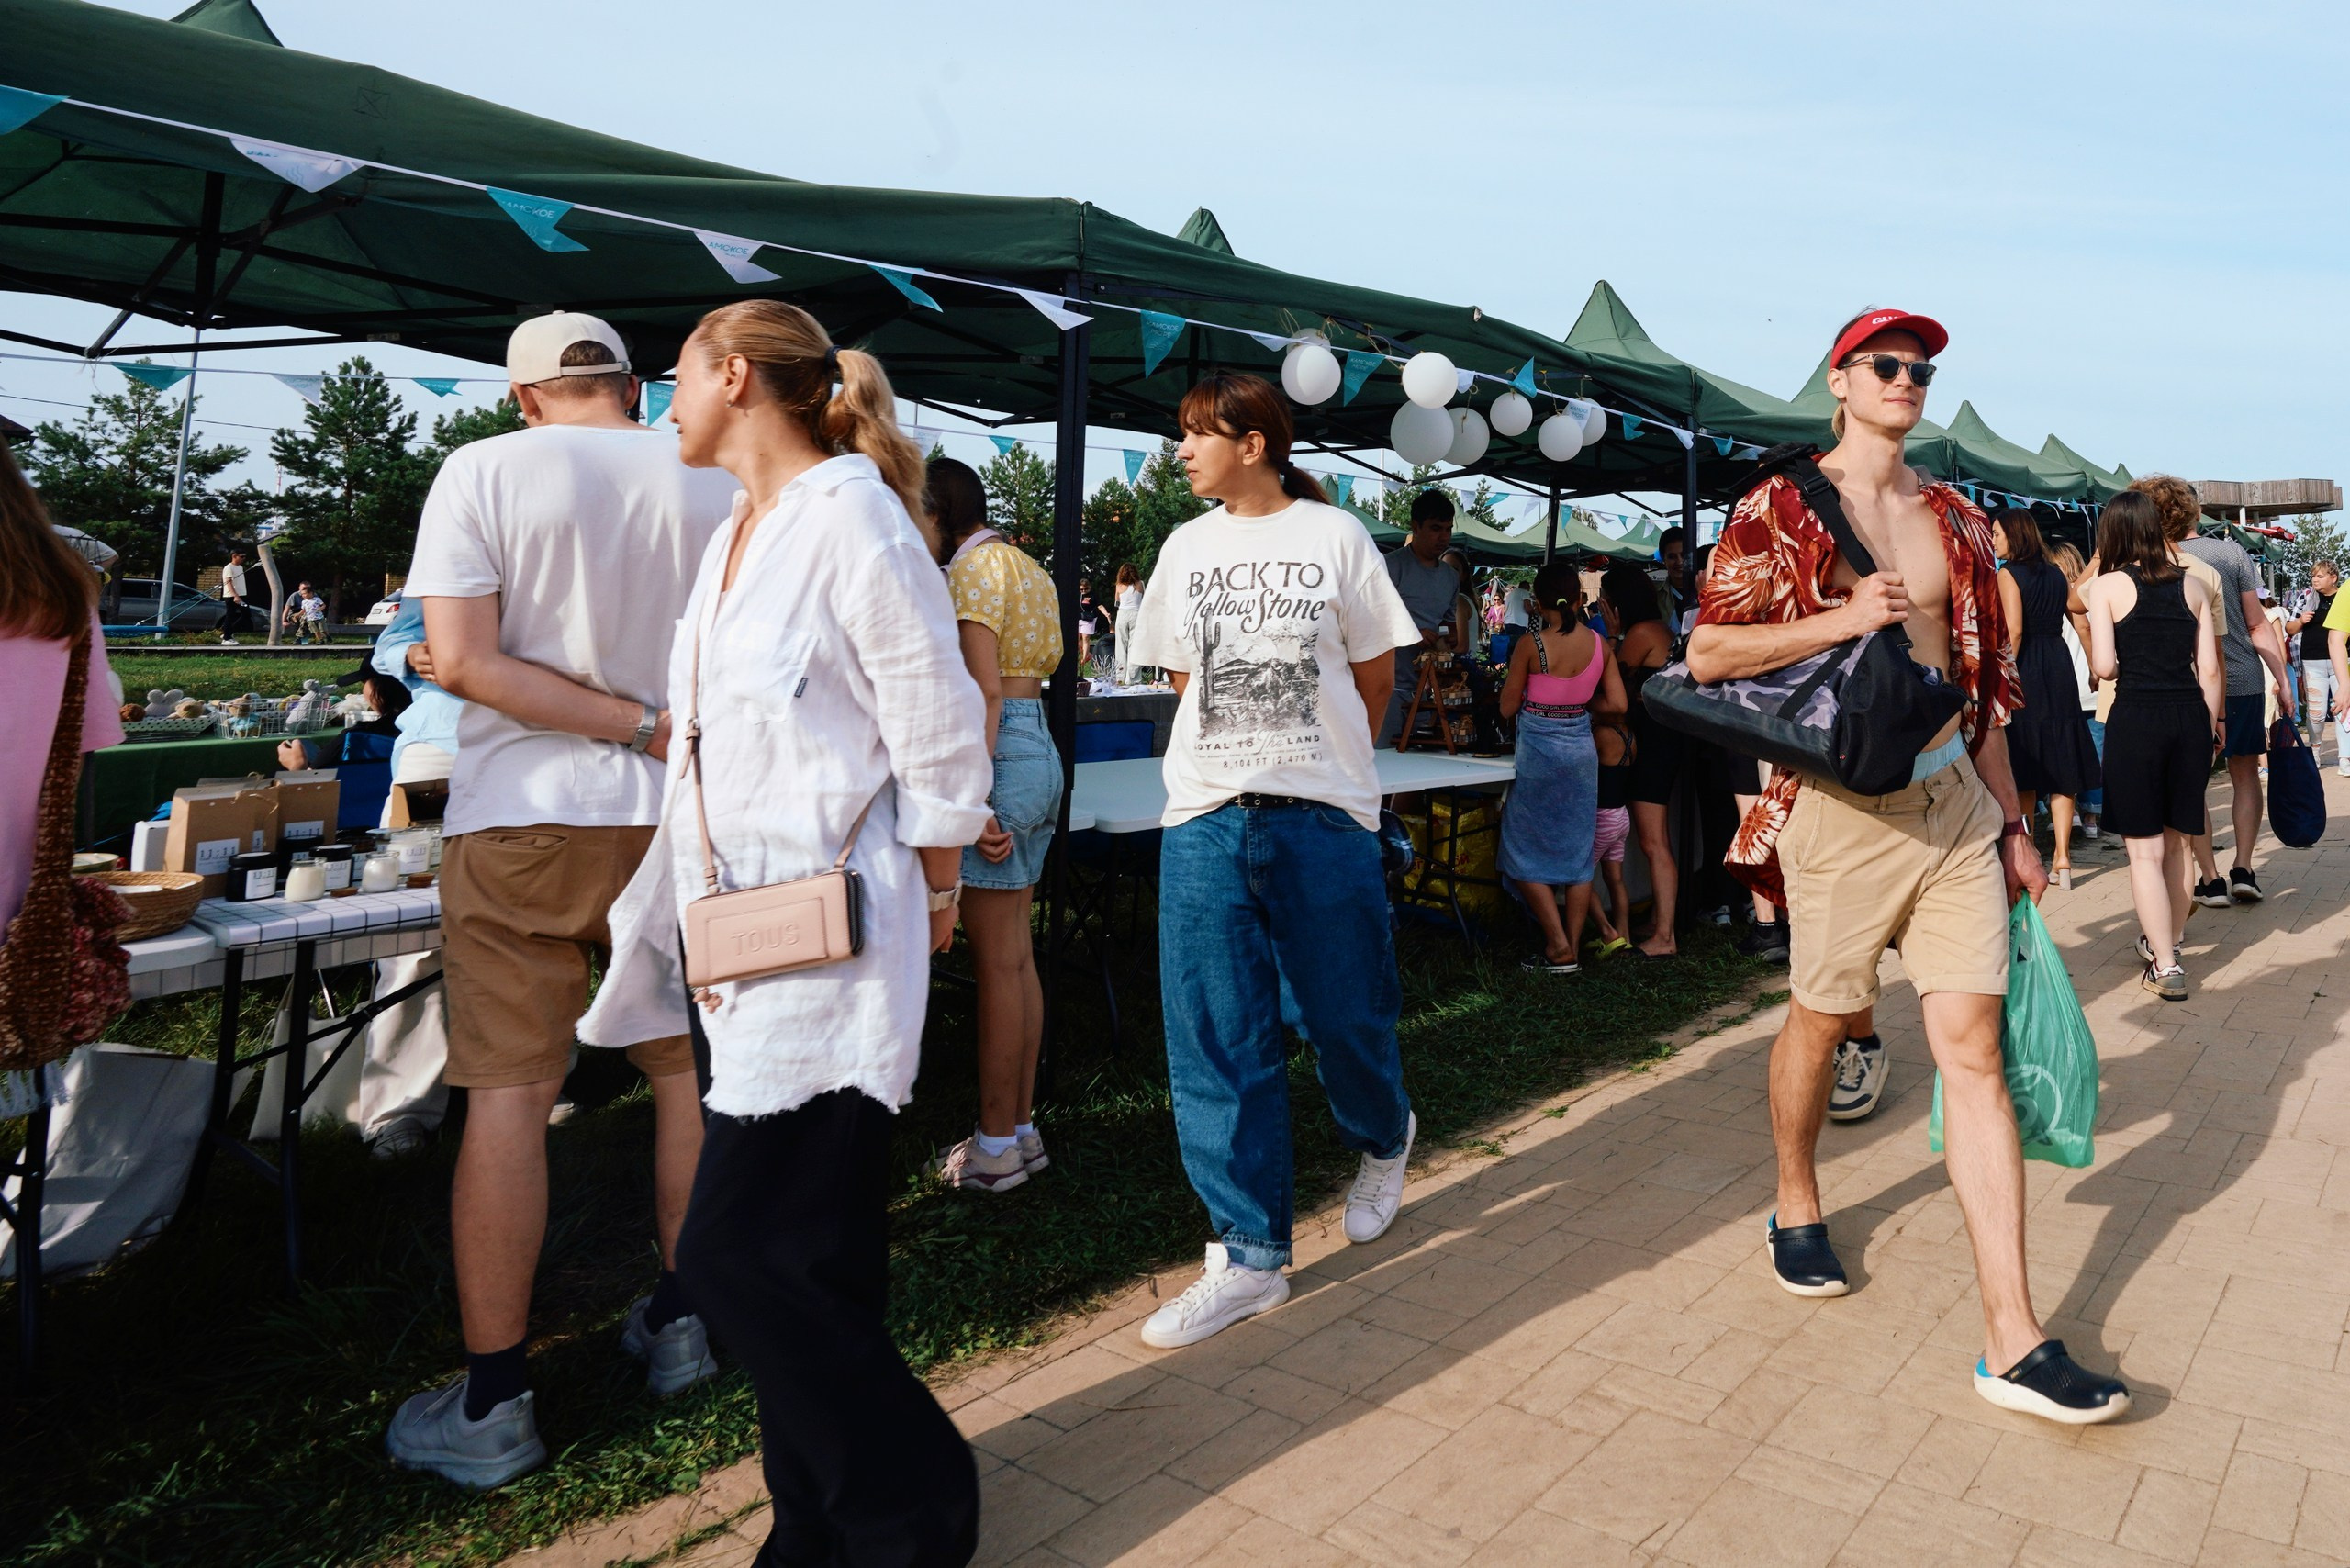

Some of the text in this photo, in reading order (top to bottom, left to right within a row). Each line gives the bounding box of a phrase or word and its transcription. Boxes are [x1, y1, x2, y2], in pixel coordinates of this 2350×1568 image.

[1190, 561, 1324, 598] BACK TO
[1237, 739, 1254, 748] TO
[1287, 734, 1320, 745] LAND
[1223, 759, 1251, 769] 8,104
[1256, 757, 1268, 766] FT
[731, 922, 800, 957] TOUS
